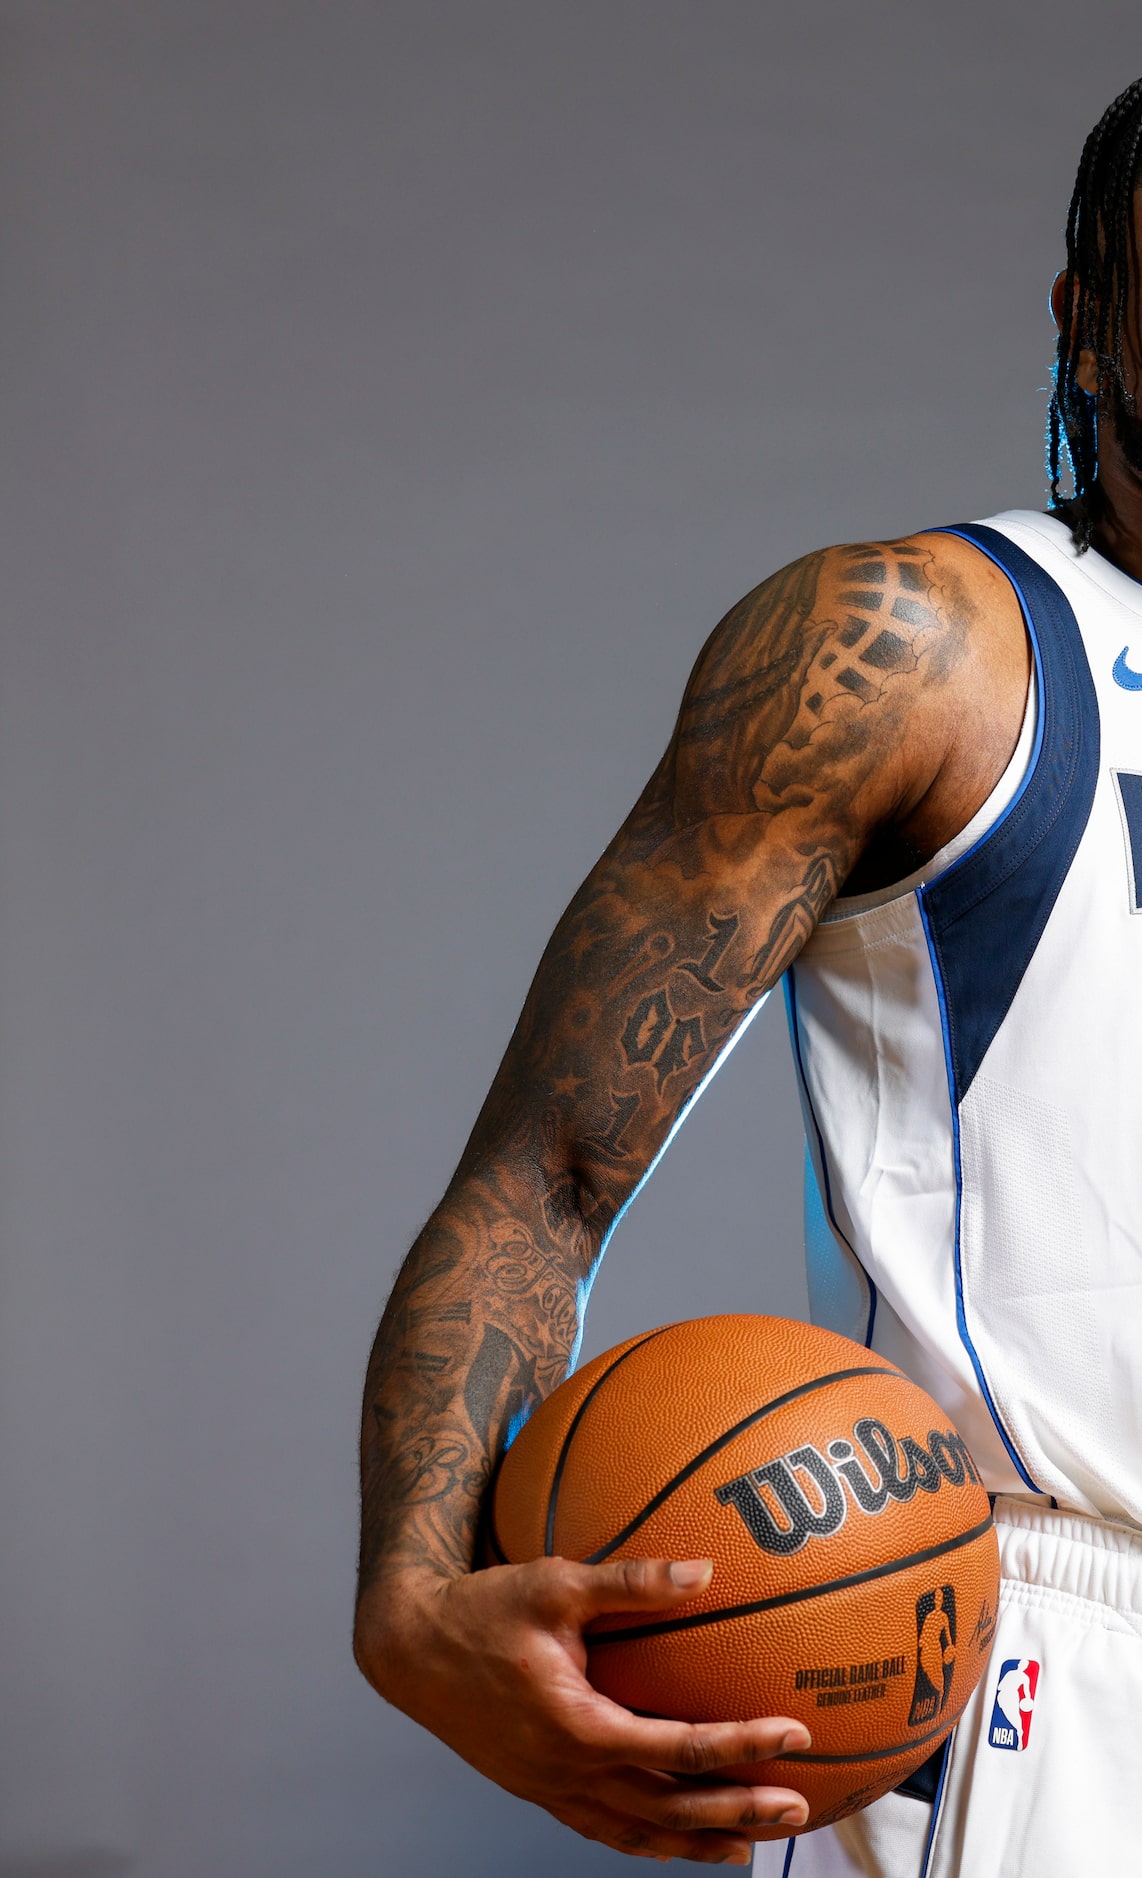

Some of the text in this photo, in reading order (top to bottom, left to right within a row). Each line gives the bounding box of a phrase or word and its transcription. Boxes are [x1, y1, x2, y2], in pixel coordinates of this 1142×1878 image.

[714, 1417, 985, 1556] Wilson
[795, 1655, 906, 1691] OFFICIAL GAME BALL
[992, 1727, 1014, 1746] NBA
